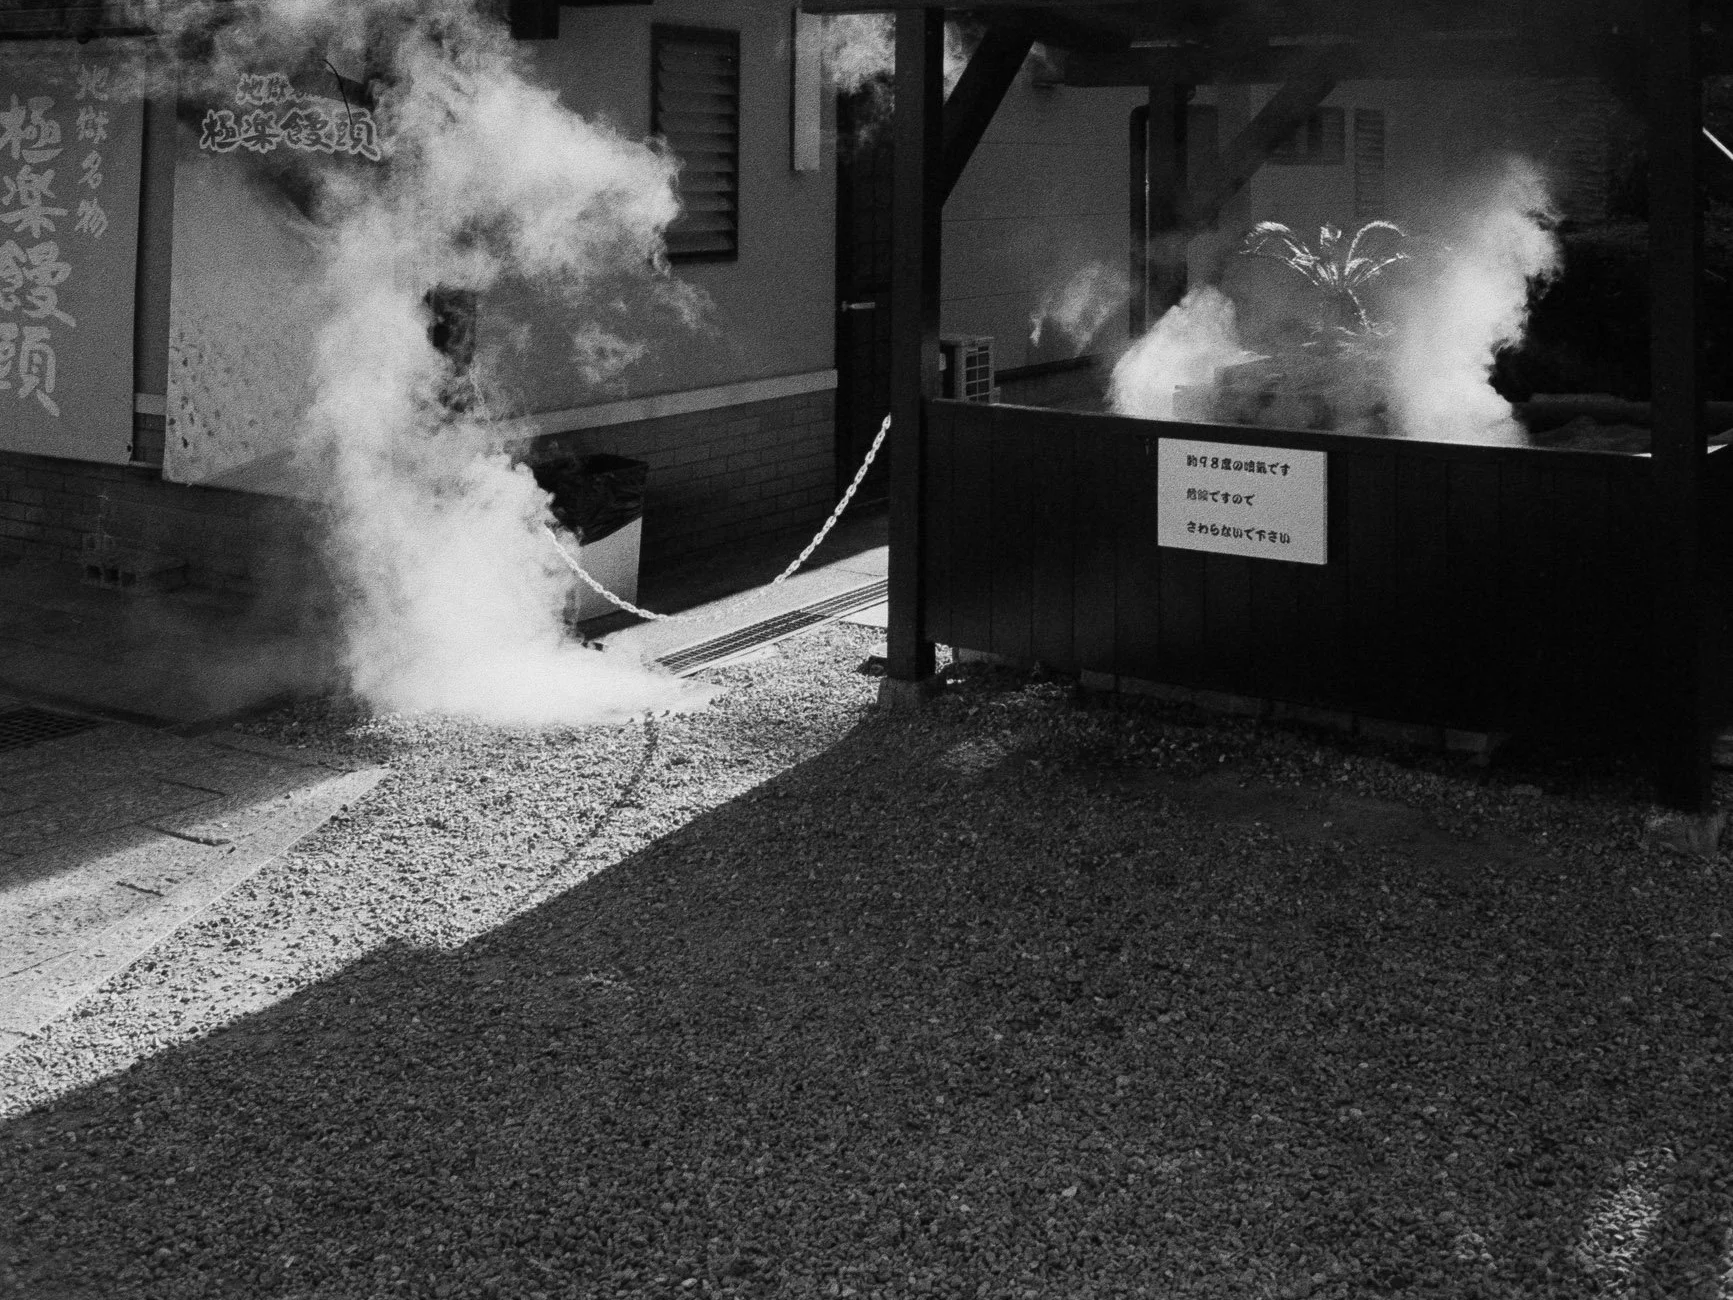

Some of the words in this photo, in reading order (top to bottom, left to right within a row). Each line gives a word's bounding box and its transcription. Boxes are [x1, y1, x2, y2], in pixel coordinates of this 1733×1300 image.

[1186, 487, 1256, 506] 危険ですので
[1186, 520, 1291, 544] さわらないで下さい
